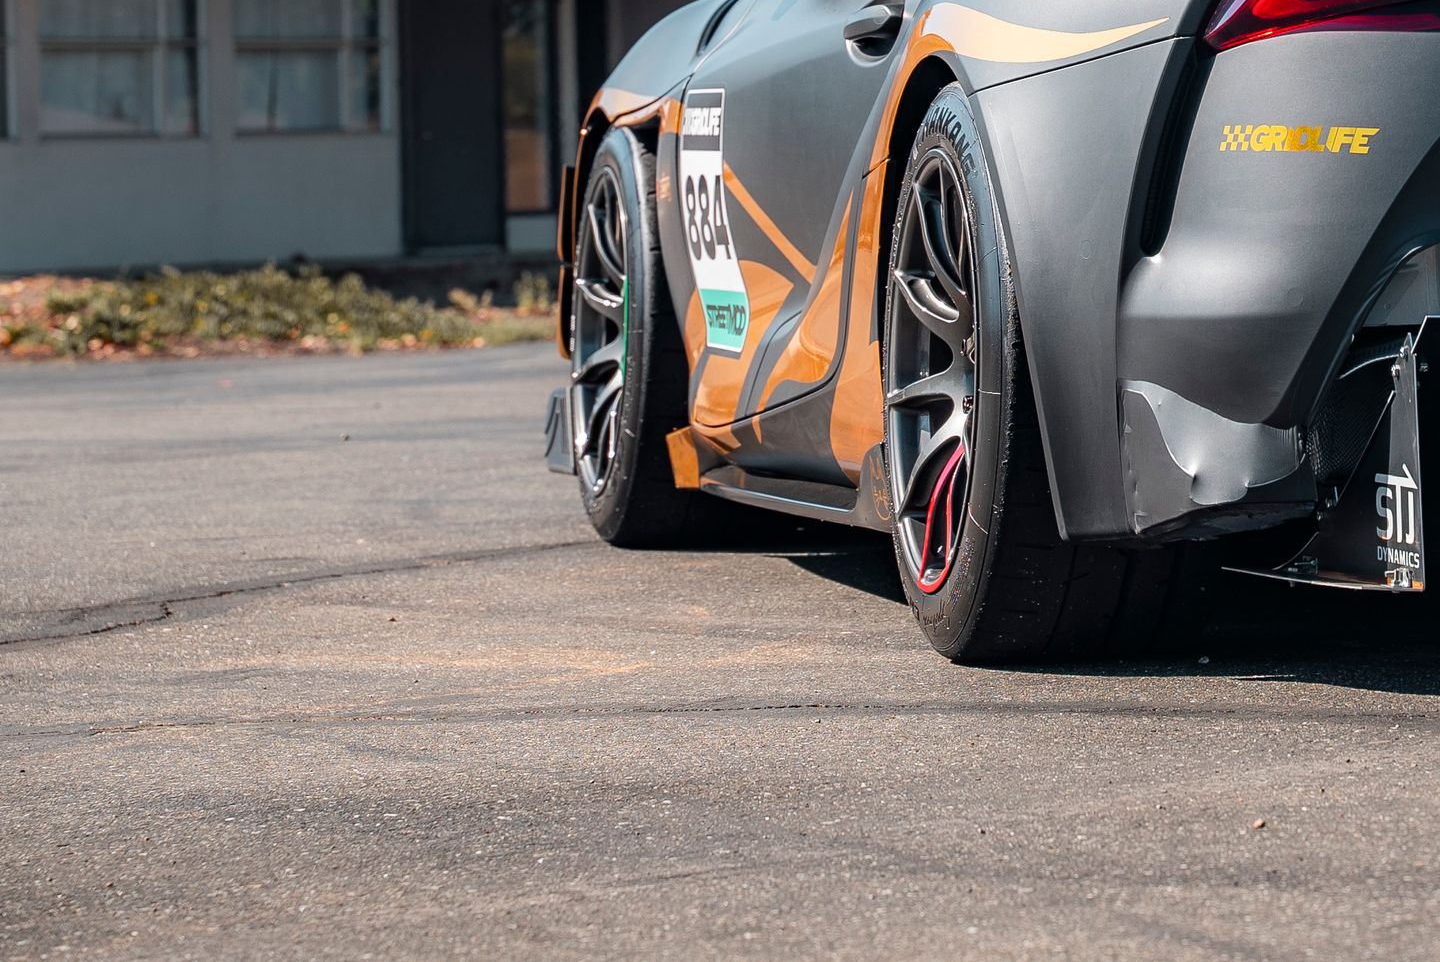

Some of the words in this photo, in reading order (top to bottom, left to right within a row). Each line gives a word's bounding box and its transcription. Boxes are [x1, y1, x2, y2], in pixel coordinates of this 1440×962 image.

[1250, 124, 1381, 155] GRIDLIFE
[685, 174, 732, 261] 884
[1377, 546, 1420, 569] DYNAMICS
